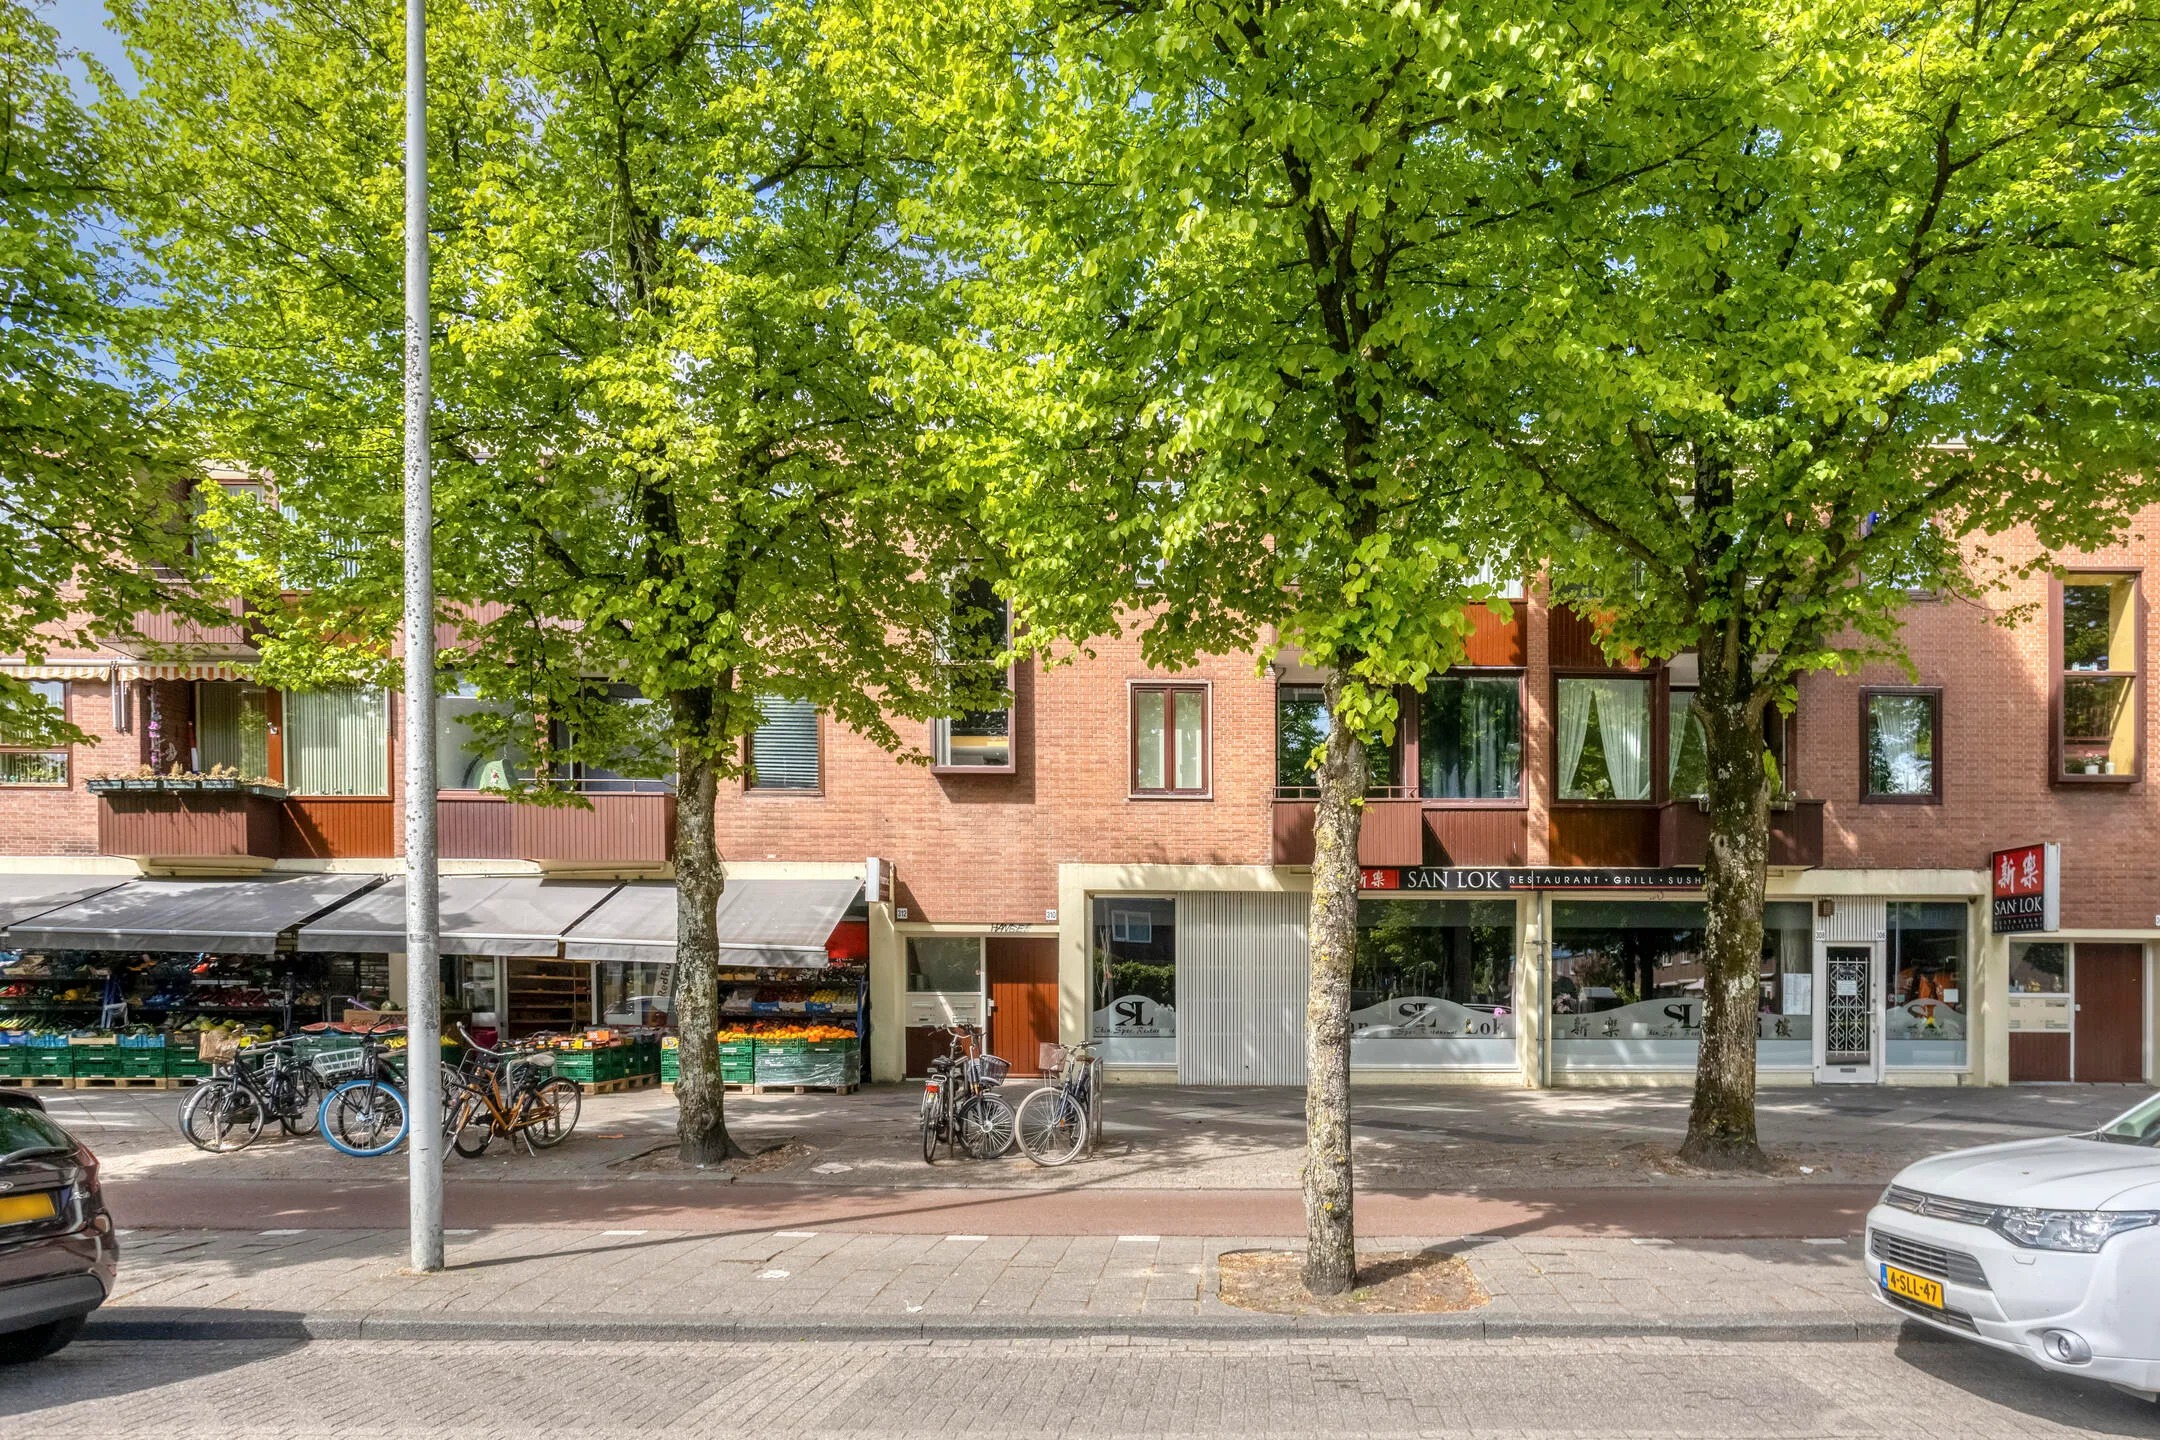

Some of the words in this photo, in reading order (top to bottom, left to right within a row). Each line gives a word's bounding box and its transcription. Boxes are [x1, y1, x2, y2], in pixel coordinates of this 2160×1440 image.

[1408, 871, 1449, 888] SAN
[1457, 871, 1501, 888] LOK
[1509, 876, 1599, 885] RESTAURANT
[1613, 876, 1653, 885] GRILL
[1668, 876, 1707, 885] SUSHI
[897, 909, 907, 917] 312
[1994, 899, 2017, 916] SAN
[2019, 896, 2042, 913] LOK
[1115, 1001, 1154, 1026] SL
[1890, 1271, 1937, 1302] 4-SLL-47
